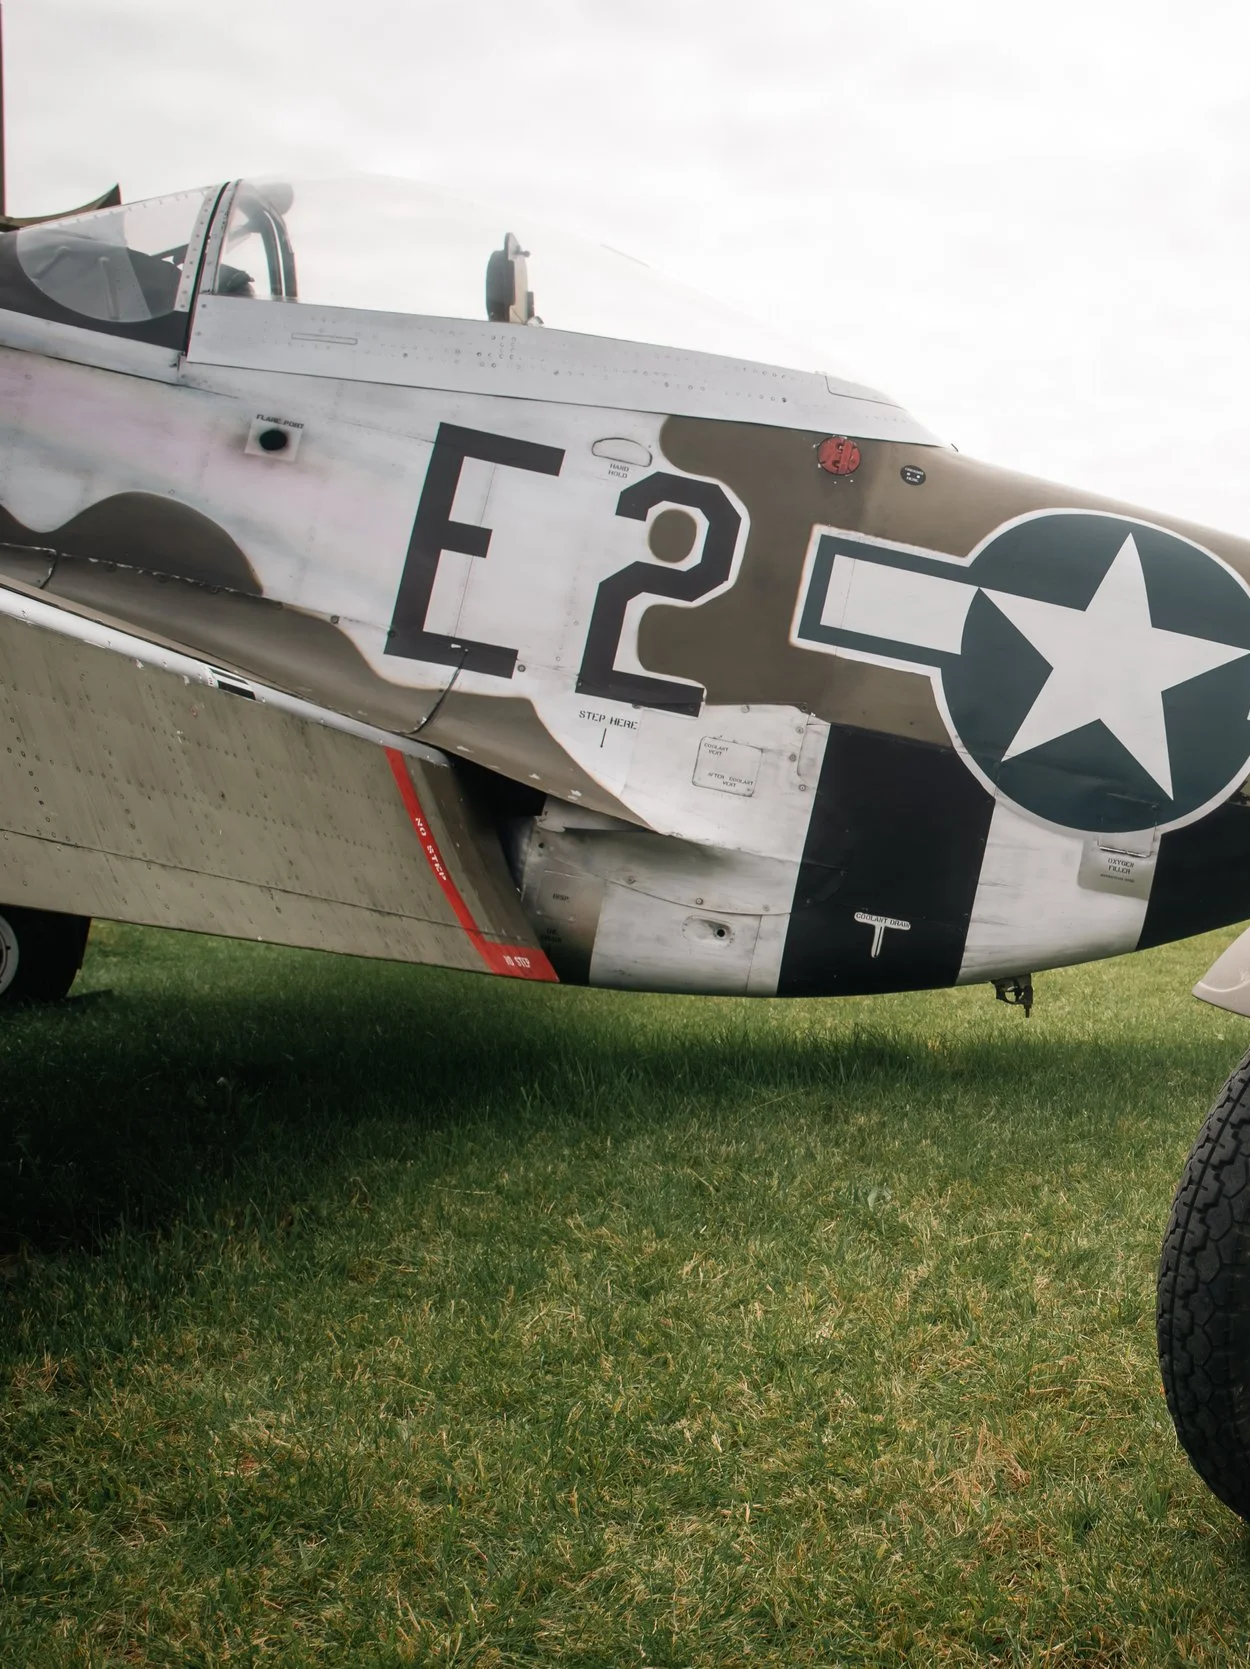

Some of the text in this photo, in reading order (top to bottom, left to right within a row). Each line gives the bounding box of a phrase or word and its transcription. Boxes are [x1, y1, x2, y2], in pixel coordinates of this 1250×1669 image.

[256, 413, 305, 429] FLARE PORT
[608, 469, 628, 479] HOLD
[579, 710, 638, 730] STEP HERE
[703, 742, 729, 752] COOLANT
[708, 749, 723, 757] VENT
[722, 780, 737, 788] VENT
[729, 776, 754, 786] COOLANT
[415, 817, 447, 881] NO STEP
[1107, 858, 1135, 869] OXYGEN
[1108, 865, 1131, 875] FILLER
[855, 912, 910, 929] COOLANT DRAIN
[502, 954, 531, 969] NO STEP
